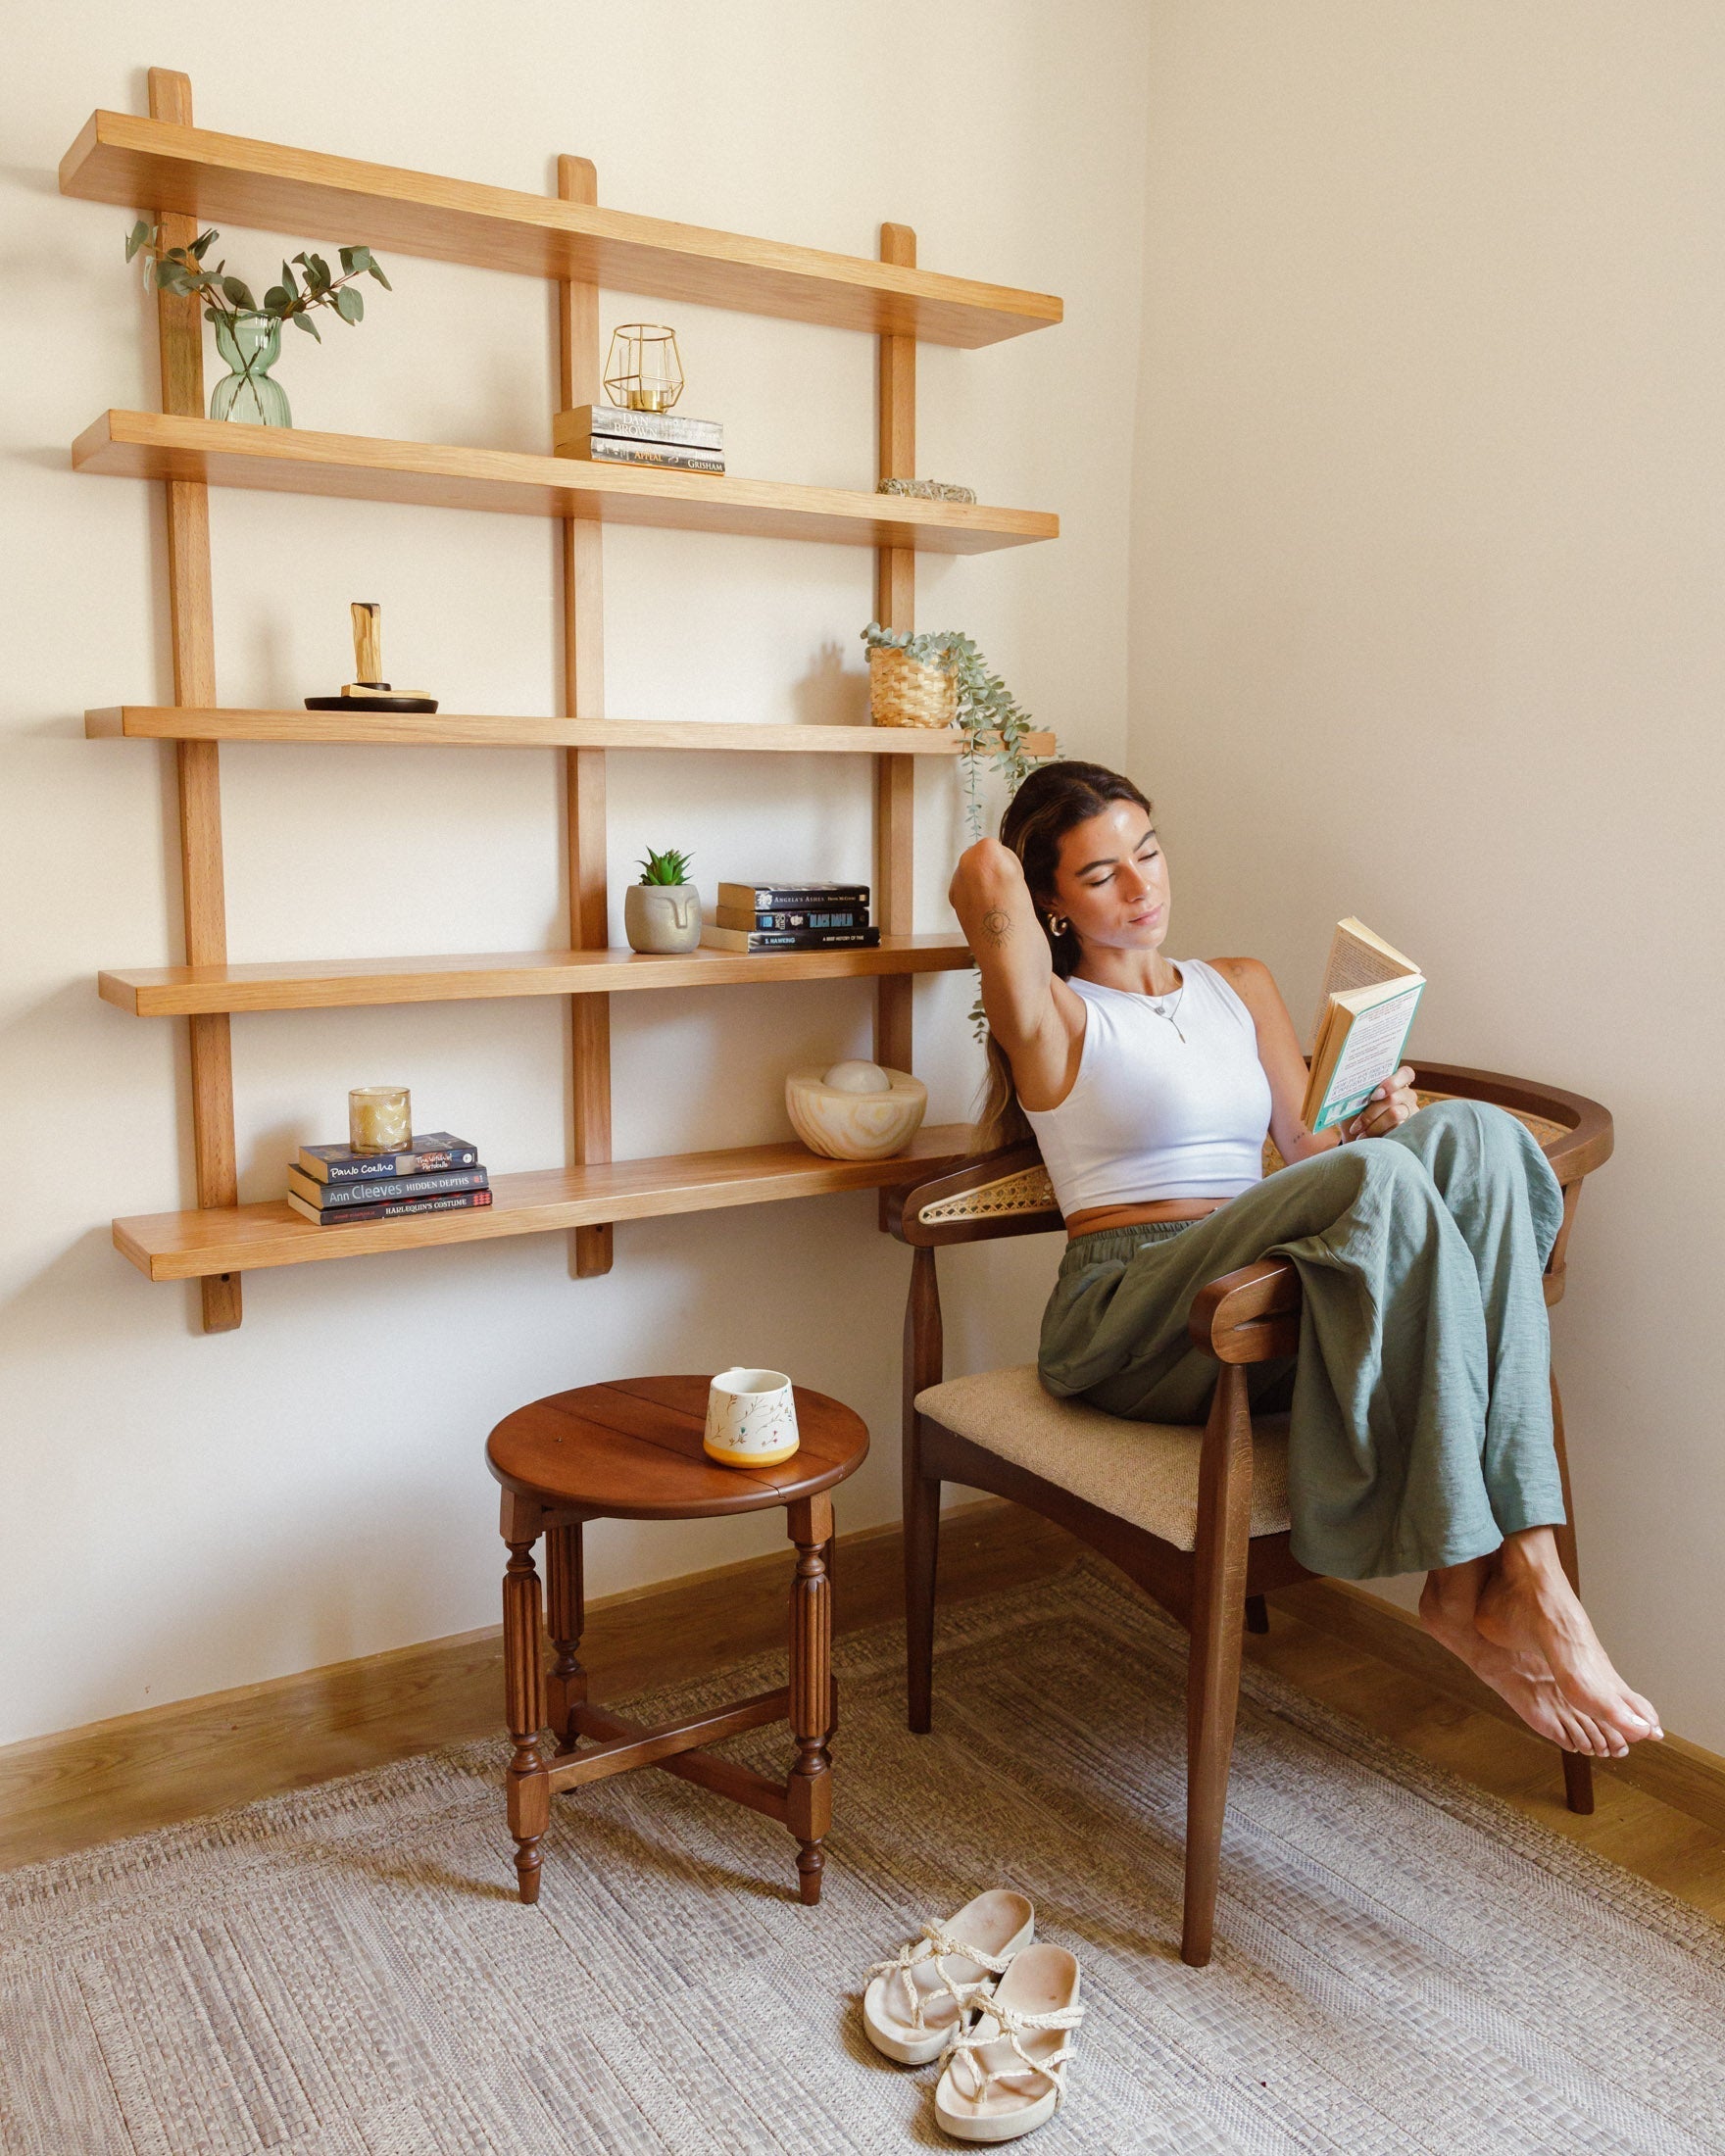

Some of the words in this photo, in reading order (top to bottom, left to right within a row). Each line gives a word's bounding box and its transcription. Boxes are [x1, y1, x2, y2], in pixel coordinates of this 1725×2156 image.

[623, 414, 649, 426] DAN
[614, 422, 658, 438] BROWN
[634, 451, 664, 462] APPEAL
[687, 459, 723, 471] GRISHAM
[330, 1166, 359, 1178] Paulo
[361, 1163, 394, 1174] Coelho
[406, 1181, 438, 1192] HIDDEN
[439, 1177, 469, 1188] DEPTHS
[329, 1192, 350, 1202] Ann
[351, 1184, 402, 1200] Cleeves
[385, 1202, 432, 1215] HARLEQUIN'S
[434, 1199, 467, 1208] COSTUME
